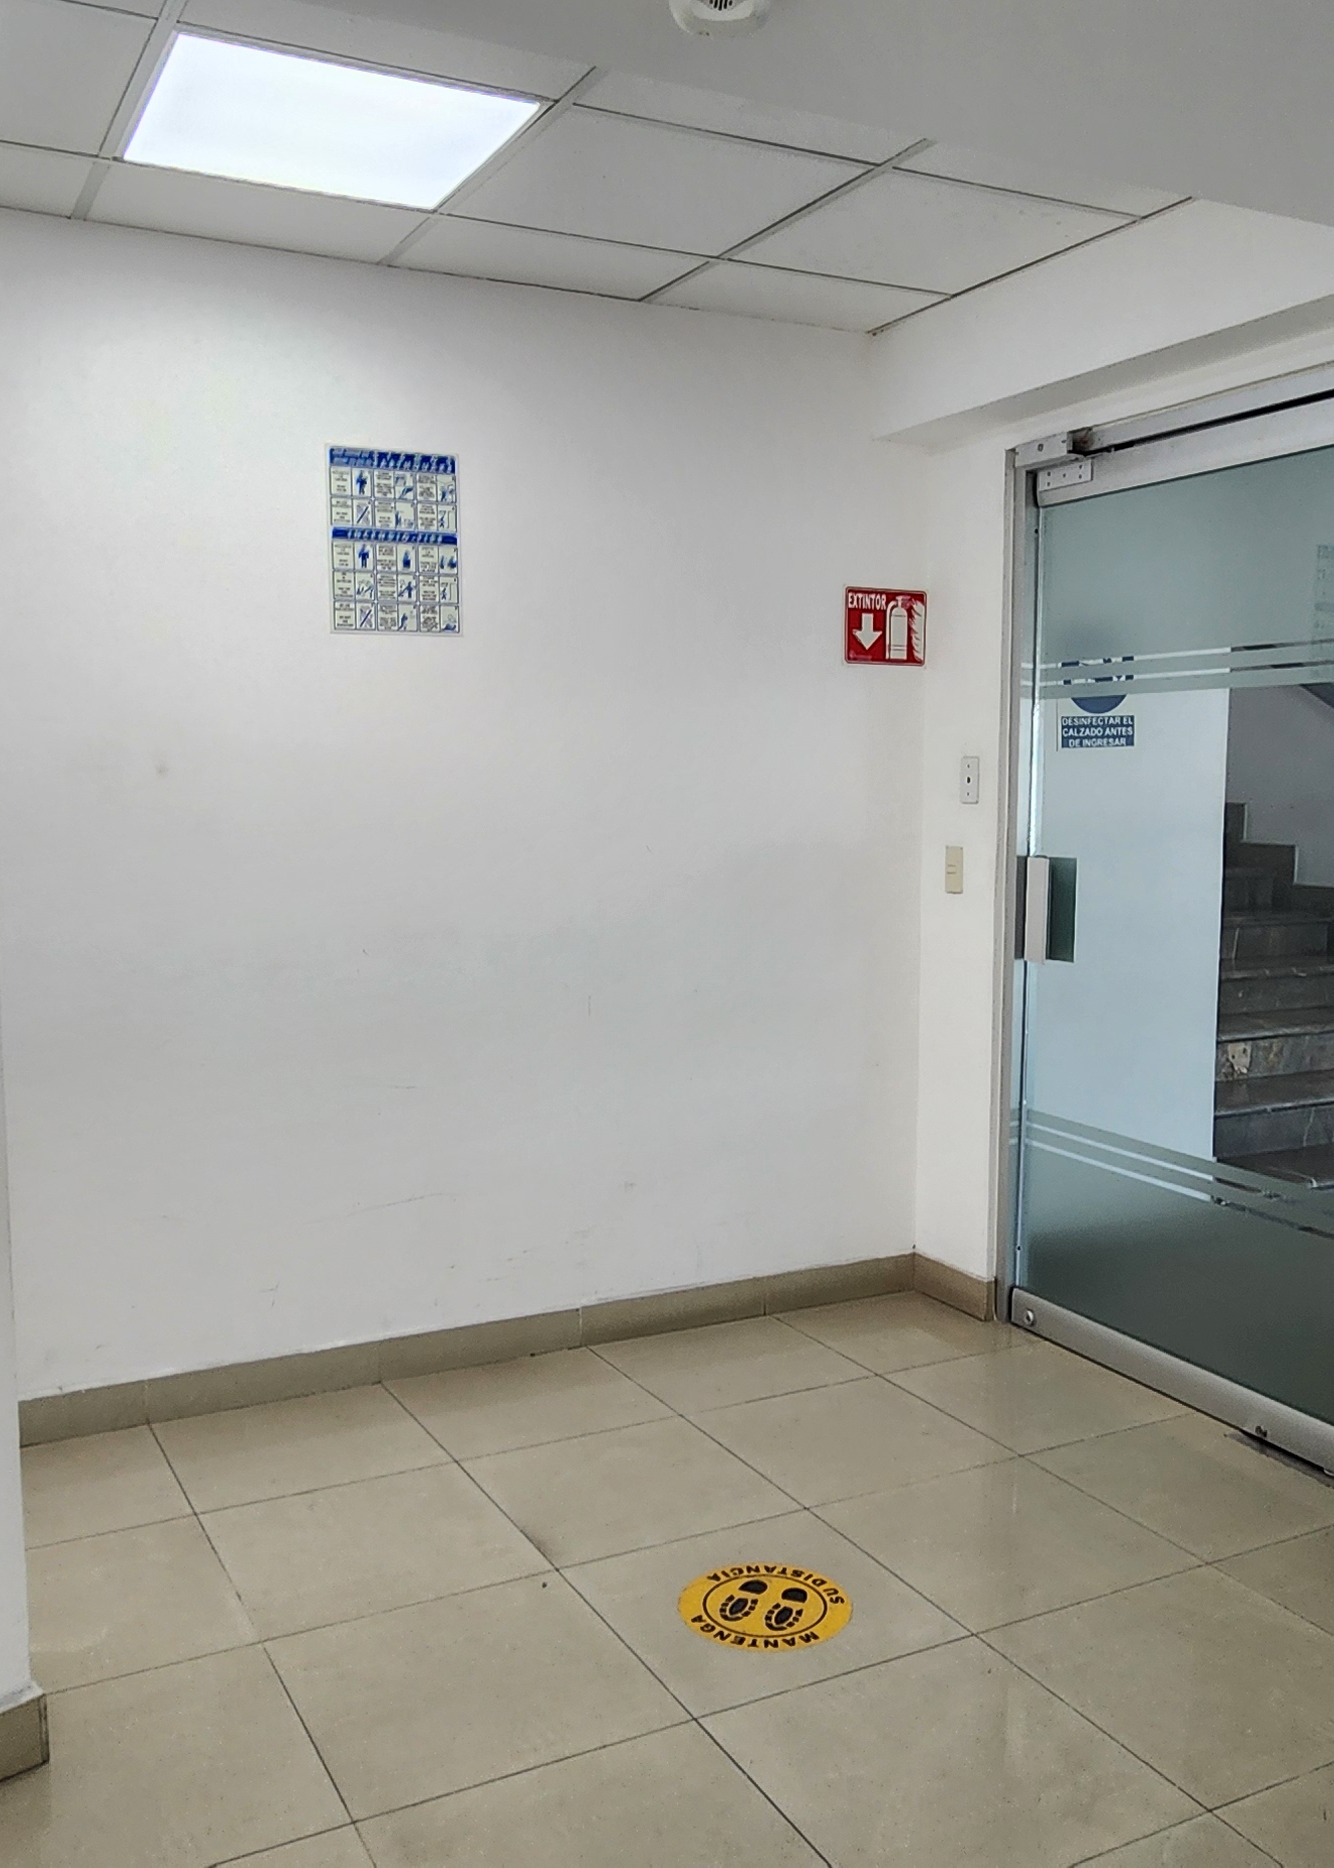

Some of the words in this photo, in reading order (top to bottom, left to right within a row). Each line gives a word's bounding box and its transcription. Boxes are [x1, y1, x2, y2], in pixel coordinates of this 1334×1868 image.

[848, 592, 886, 610] EXTINTOR
[1062, 716, 1121, 726] DESINFECTAR
[1123, 716, 1133, 725] EL
[1062, 727, 1103, 737] CALZADO
[1104, 726, 1133, 736] ANTES
[1069, 738, 1080, 747] DE
[1082, 737, 1127, 747] INGRESAR
[706, 1564, 827, 1588] DISTANCIA
[823, 1587, 845, 1605] SU
[690, 1614, 820, 1649] MANTENGA
